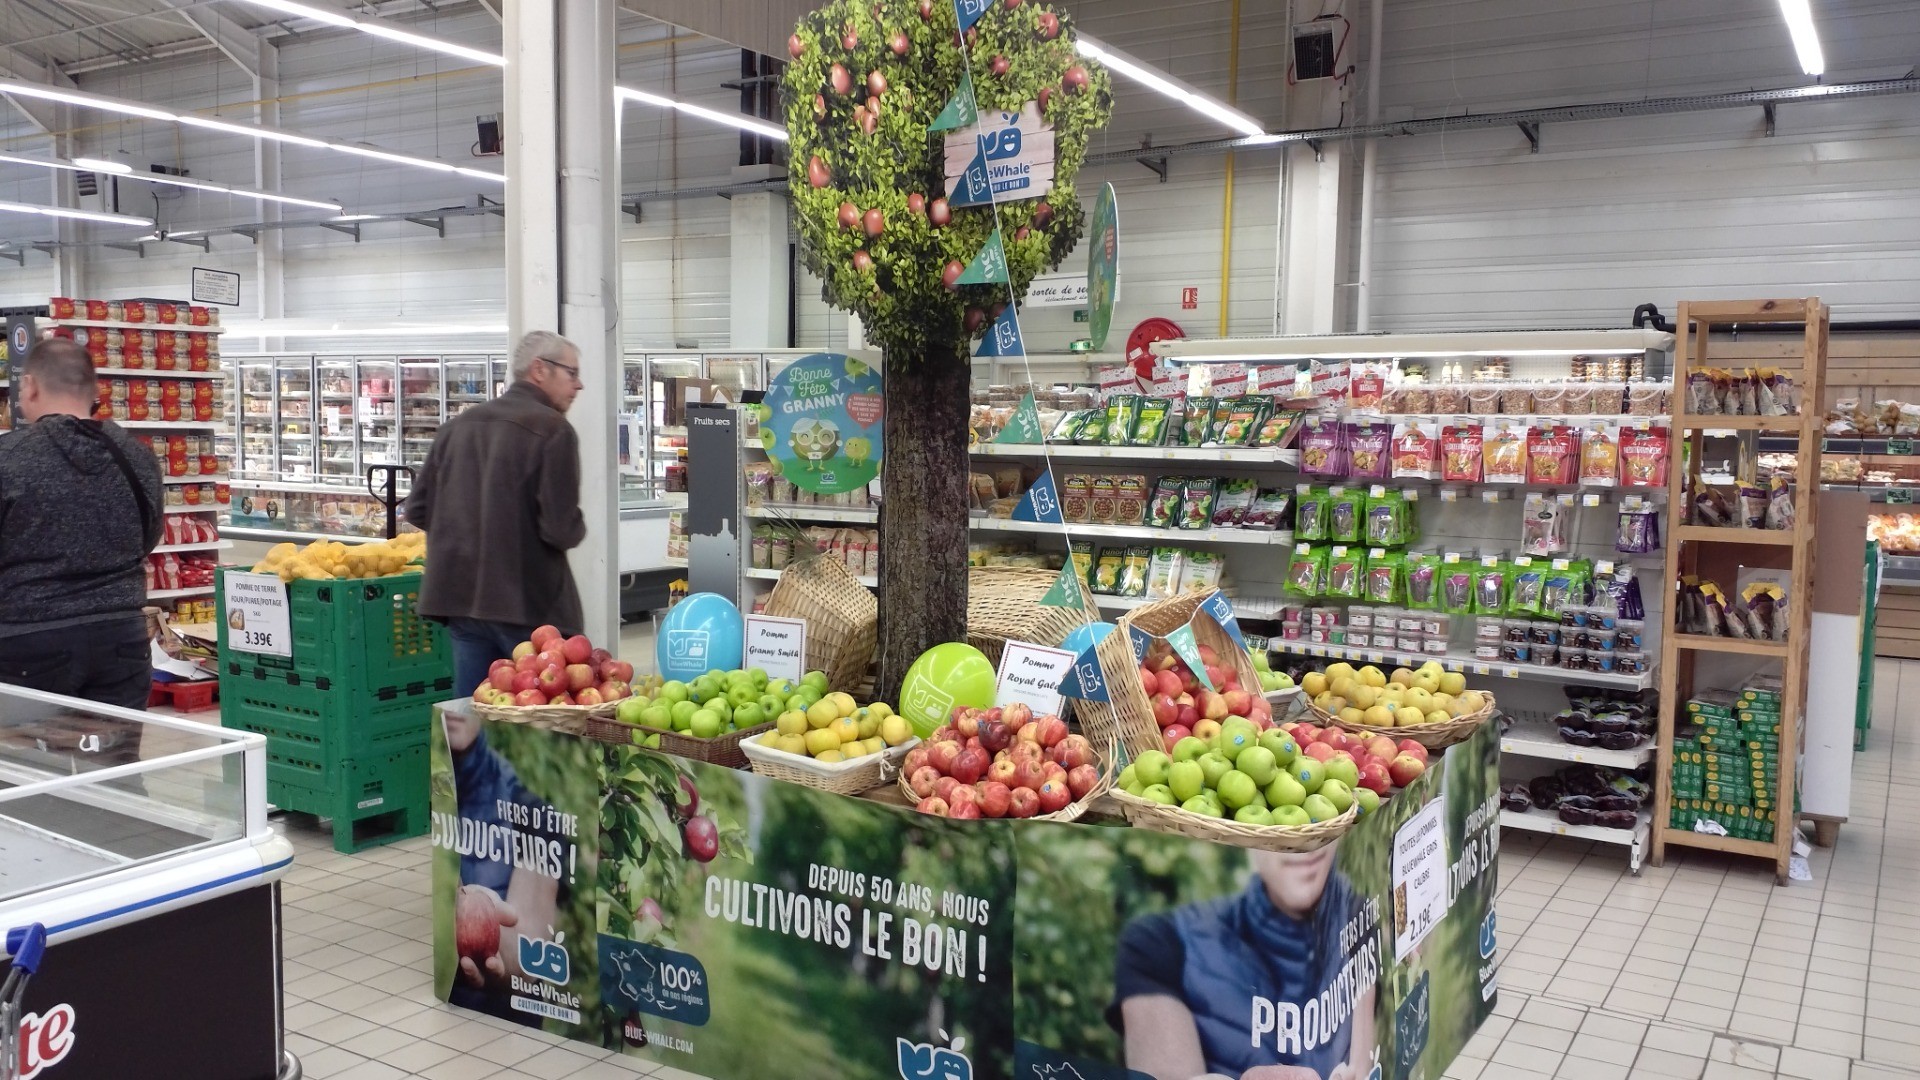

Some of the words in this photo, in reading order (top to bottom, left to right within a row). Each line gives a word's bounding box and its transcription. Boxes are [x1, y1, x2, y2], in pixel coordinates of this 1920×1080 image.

[989, 162, 1030, 178] eWhale
[981, 248, 995, 279] 50
[1032, 287, 1056, 296] sortie
[1061, 285, 1072, 294] de
[789, 367, 832, 382] Bonne
[798, 381, 827, 397] Fête
[782, 392, 846, 414] GRANNY
[694, 416, 714, 426] Fruits
[1017, 408, 1032, 439] 50
[1159, 479, 1182, 488] Lunor
[235, 583, 253, 592] POMME
[254, 584, 261, 592] DE
[261, 585, 277, 593] TERRE
[1061, 573, 1074, 604] 50
[245, 631, 273, 647] 3.39€
[761, 628, 788, 639] Pomme
[749, 645, 775, 657] Granny
[777, 648, 799, 658] Smith
[1022, 656, 1055, 670] Pomme
[1007, 673, 1036, 686] Royal
[497, 799, 529, 827] FIERS
[532, 804, 579, 838] D'ÊTRE
[1400, 836, 1416, 856] TOUTES
[569, 844, 577, 884] !
[1402, 848, 1426, 876] BLUEWHALE
[1426, 839, 1438, 856] GROS
[808, 862, 866, 898] DEPUIS
[870, 875, 893, 904] 50
[896, 882, 935, 918] ANS,
[942, 890, 990, 926] NOUS
[704, 875, 851, 949] CULTIVONS
[862, 908, 893, 960] LE
[902, 917, 967, 979] BON
[978, 934, 987, 983] !
[1410, 903, 1431, 942] 2.19€
[1339, 916, 1358, 959] FIERS
[660, 961, 702, 992] 100%
[511, 975, 580, 1008] BlueWhale
[661, 988, 669, 998] de
[670, 992, 681, 1000] nos
[681, 993, 704, 1006] régions
[1252, 936, 1377, 1055] PRODUCTEURS
[1377, 928, 1384, 976] !
[517, 998, 548, 1013] CULTIVONS
[549, 1007, 556, 1016] LE
[557, 1009, 569, 1019] BON
[19, 1008, 71, 1078] te
[624, 1025, 694, 1055] BLUE-WHALE.COM
